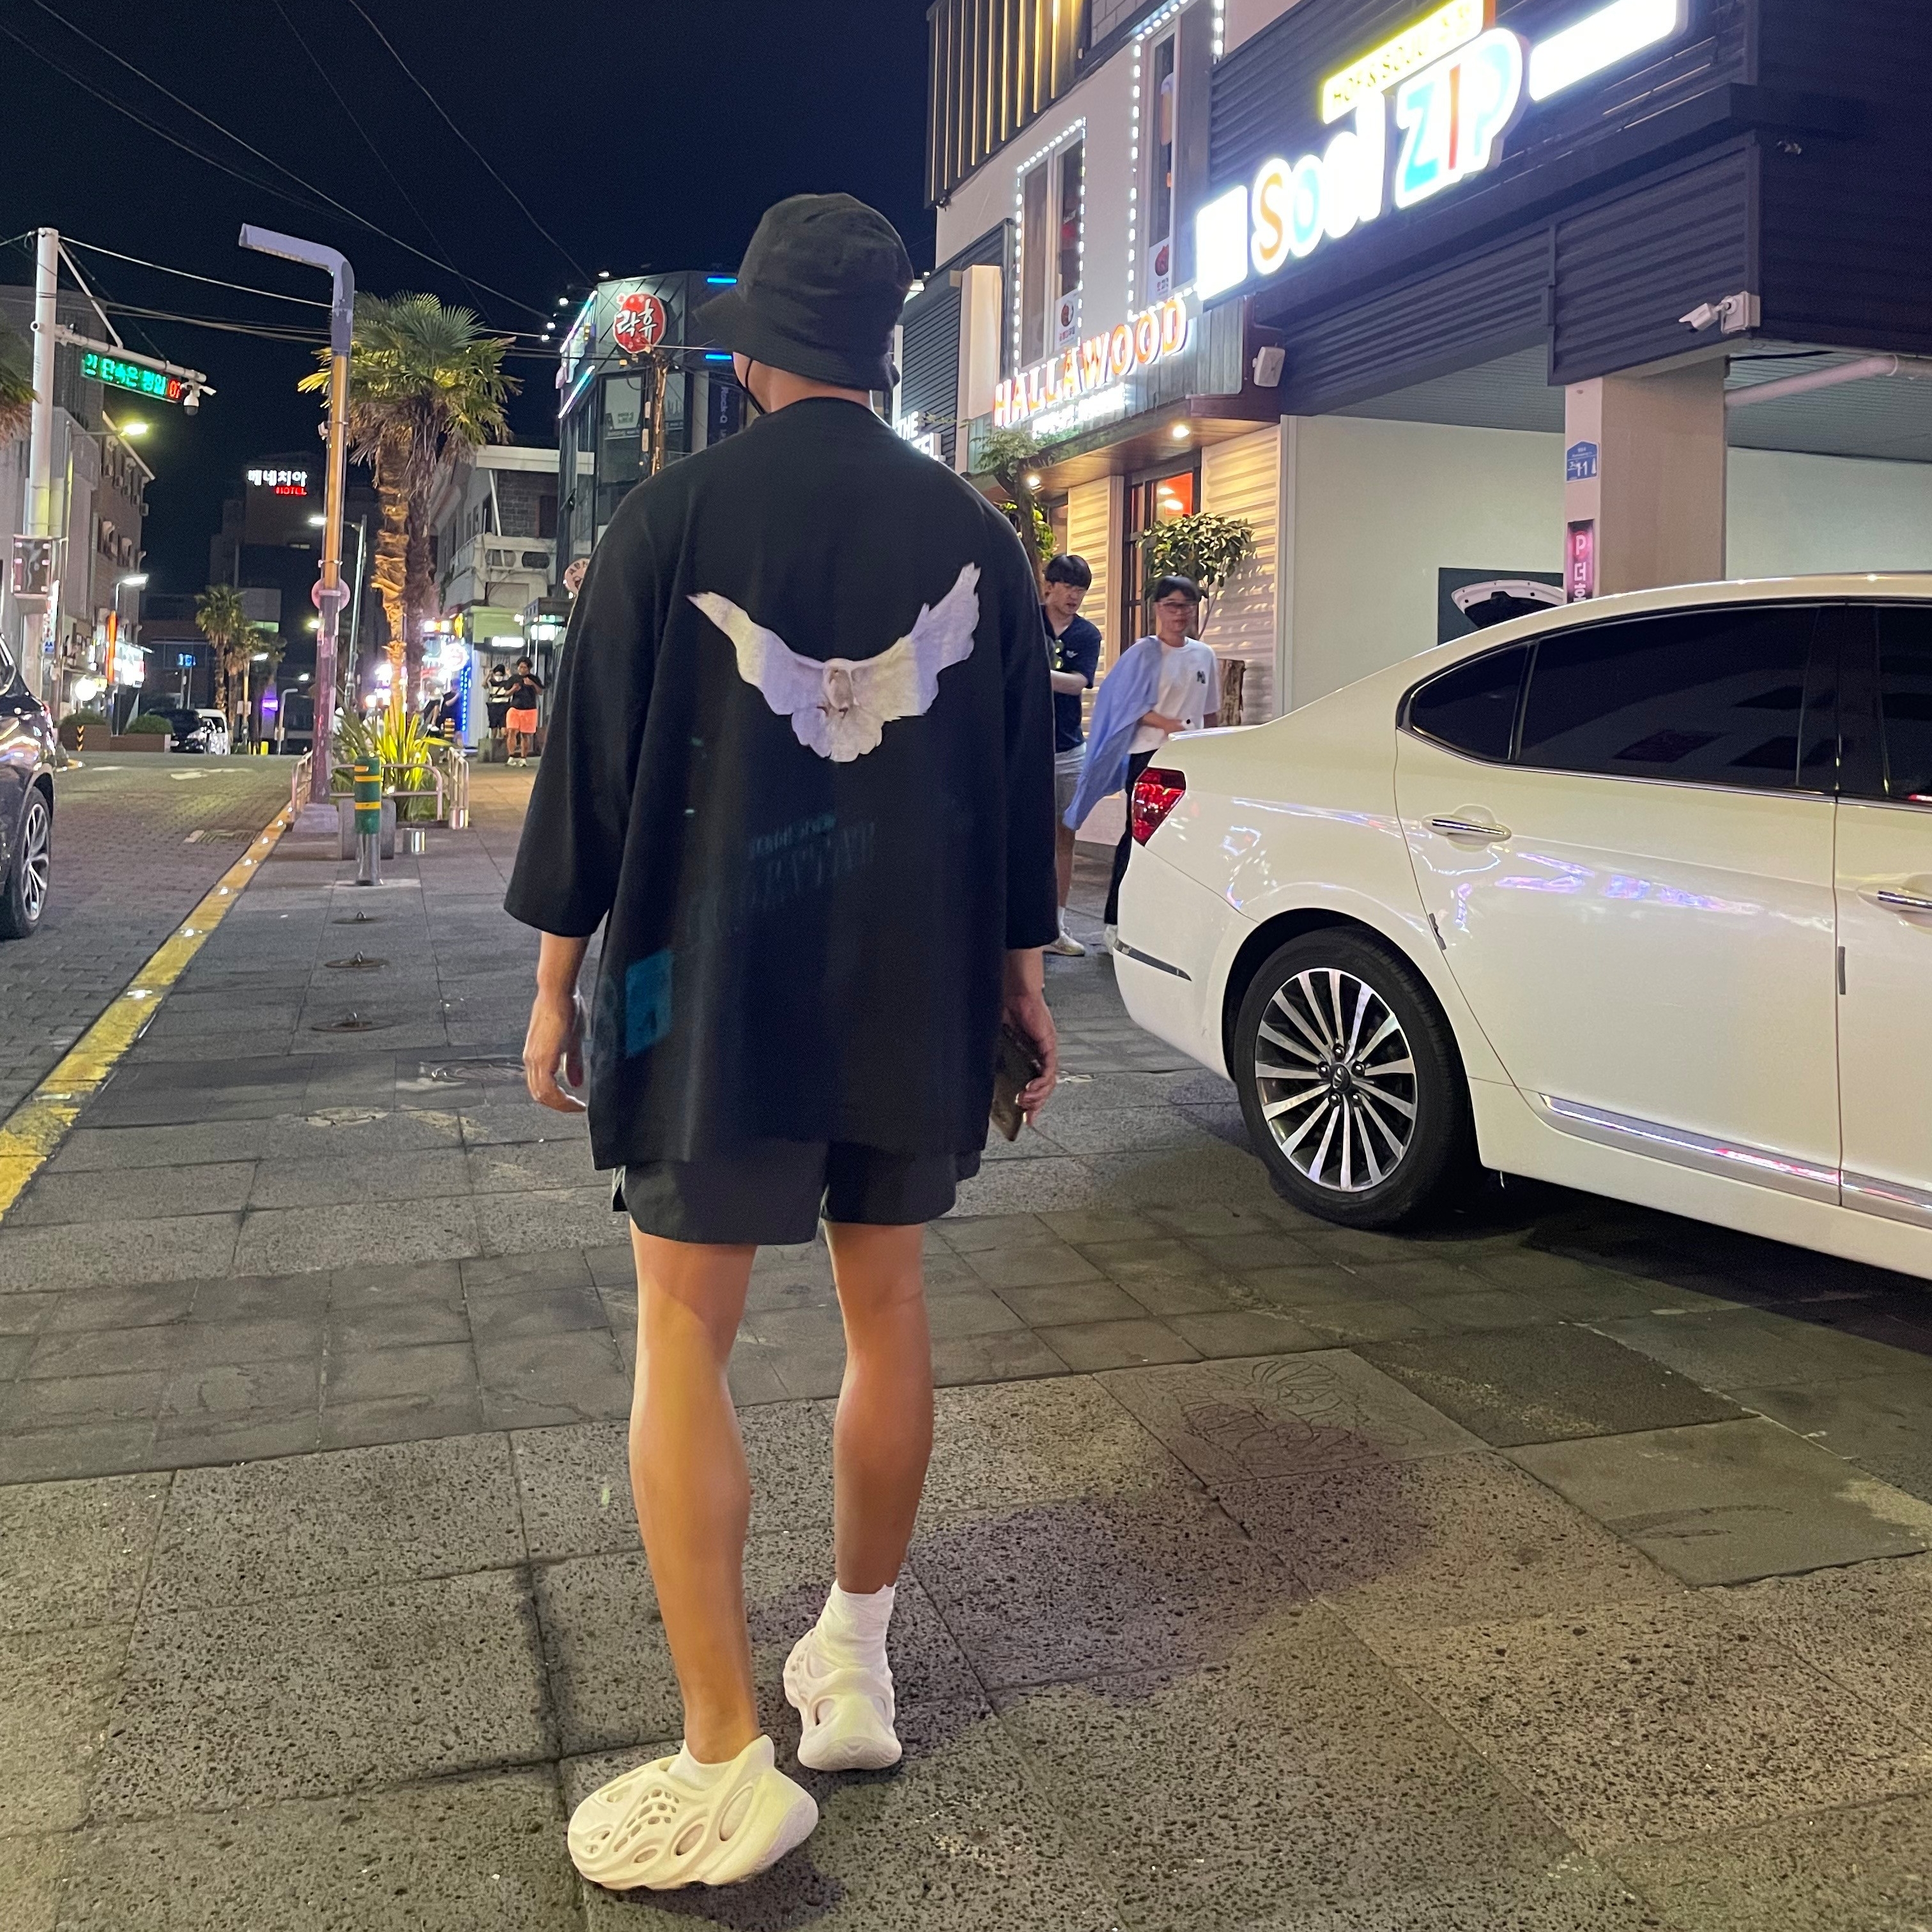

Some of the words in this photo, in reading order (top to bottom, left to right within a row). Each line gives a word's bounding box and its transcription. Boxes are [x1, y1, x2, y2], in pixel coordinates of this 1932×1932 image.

[1397, 29, 1521, 207] ZIP
[994, 298, 1187, 427] HALLAWOOD
[248, 470, 307, 487] 베네치아
[1575, 535, 1586, 555] P
